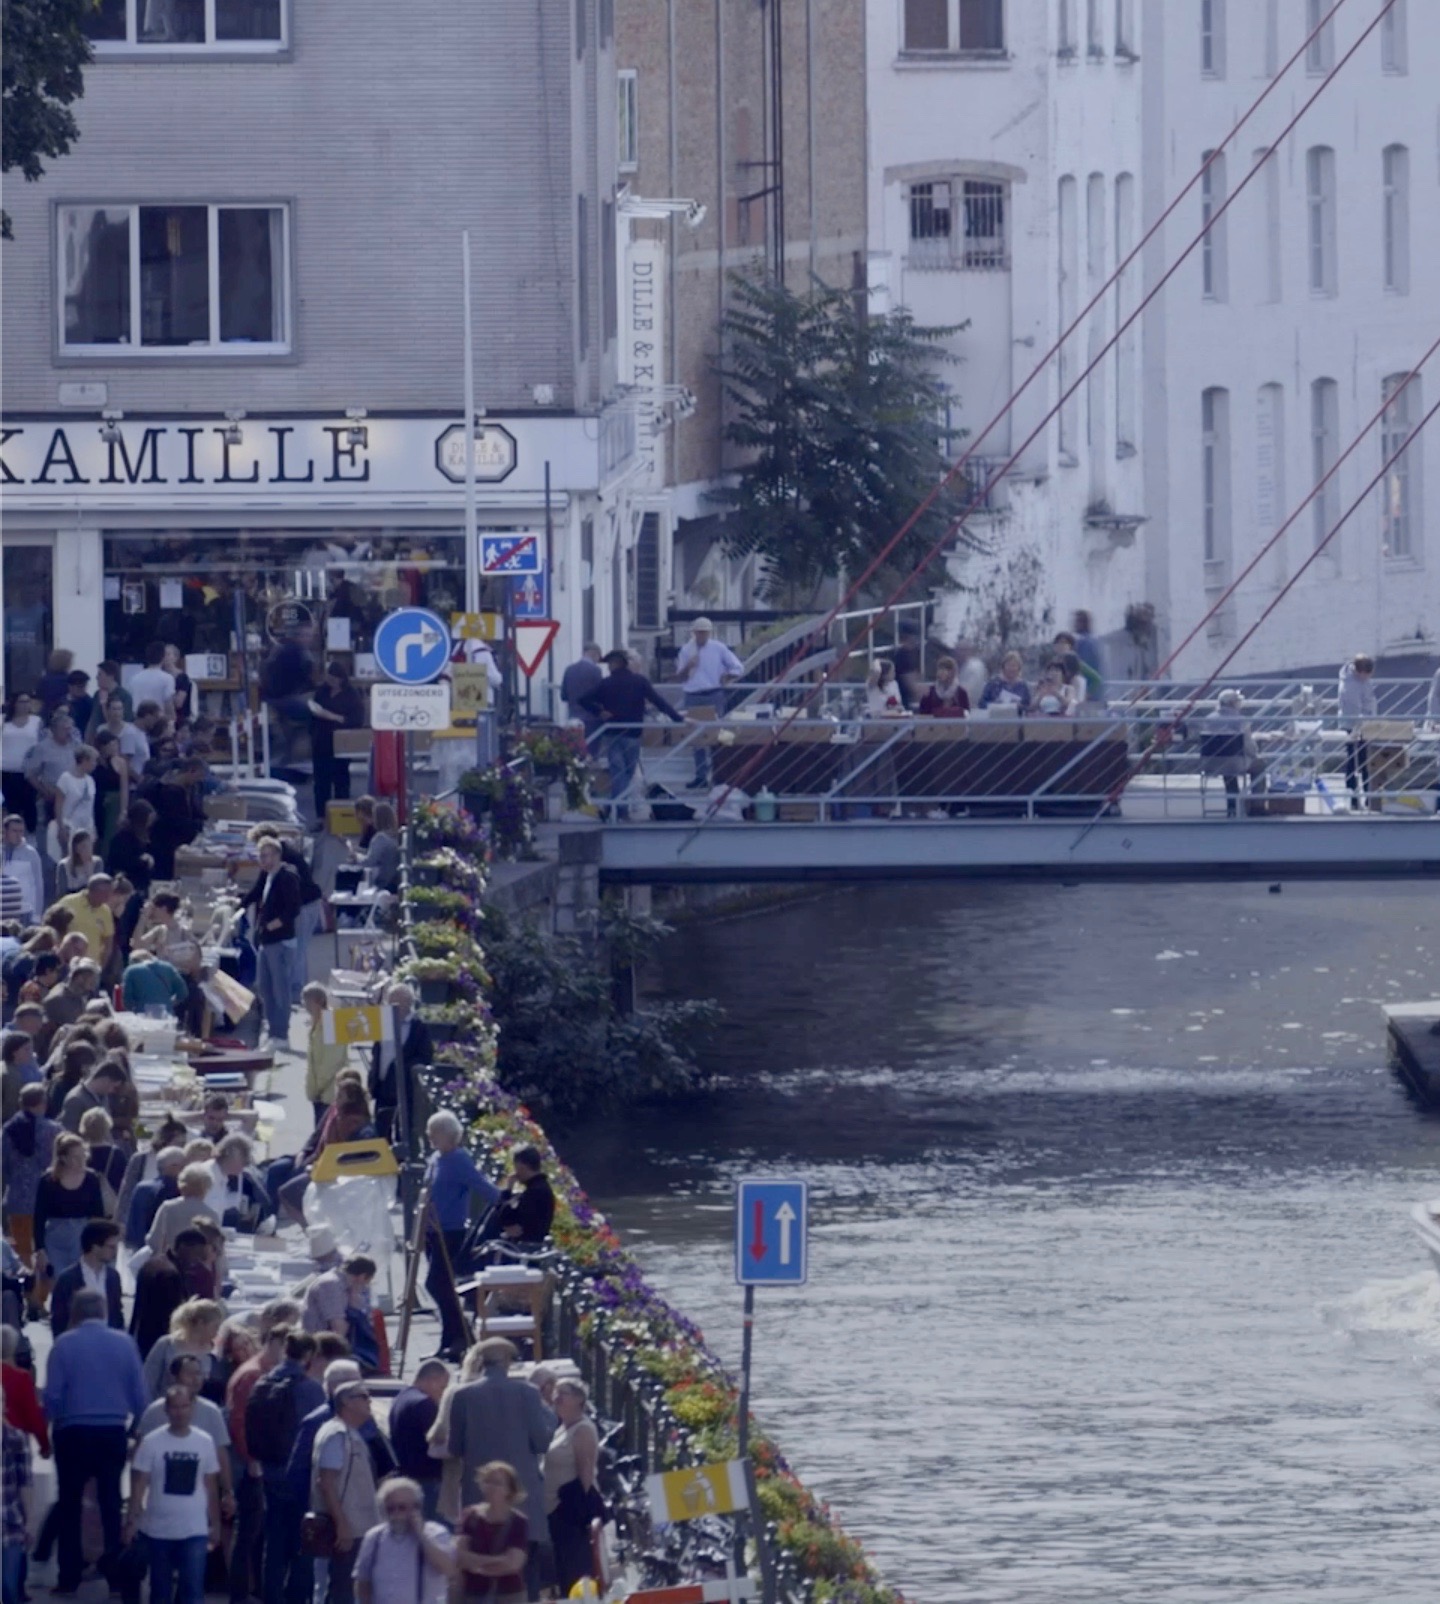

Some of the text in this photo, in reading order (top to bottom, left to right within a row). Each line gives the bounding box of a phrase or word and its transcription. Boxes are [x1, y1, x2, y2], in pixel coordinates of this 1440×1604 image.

[632, 261, 653, 331] DILLE
[633, 341, 654, 358] &
[451, 442, 488, 454] DILE
[448, 454, 505, 466] KAILLE
[377, 688, 444, 698] UITGEZONDERD
